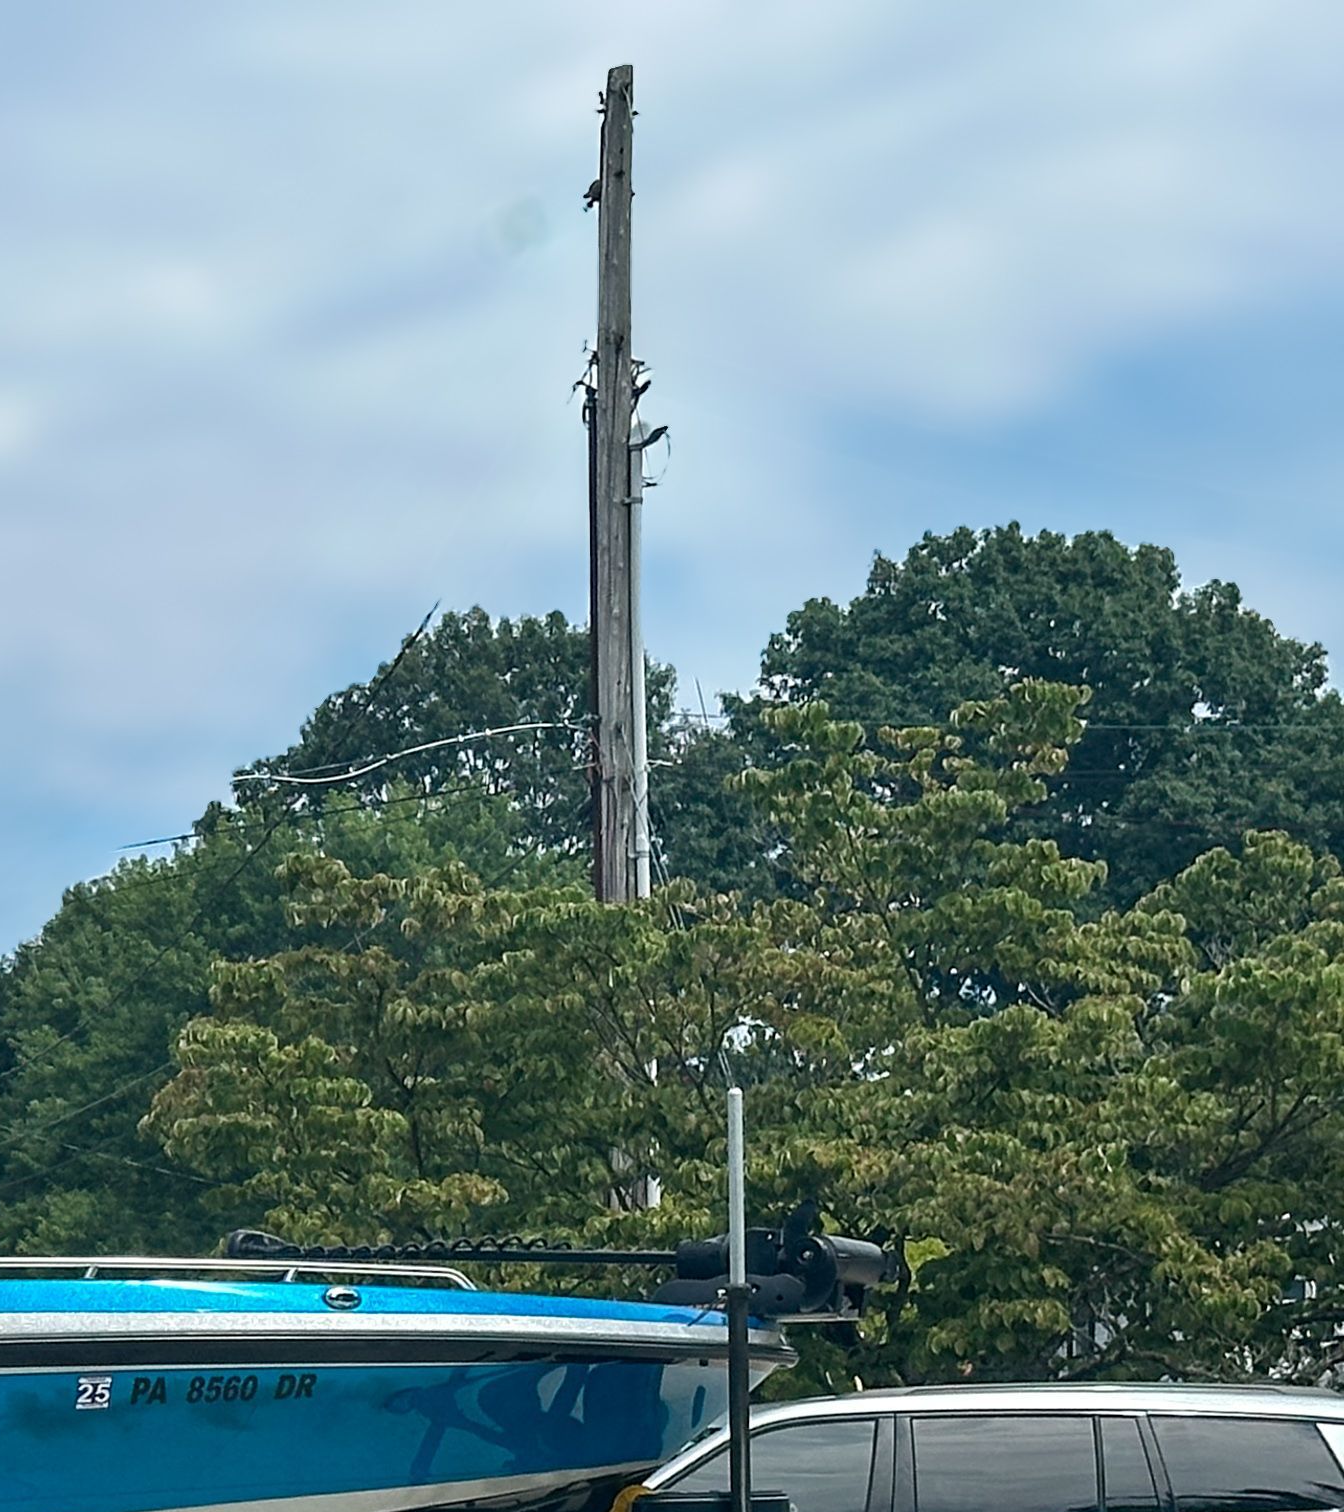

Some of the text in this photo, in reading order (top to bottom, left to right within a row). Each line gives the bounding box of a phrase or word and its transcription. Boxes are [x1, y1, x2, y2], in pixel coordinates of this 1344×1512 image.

[77, 1384, 110, 1403] 25
[131, 1374, 317, 1404] PA 8560 DR
